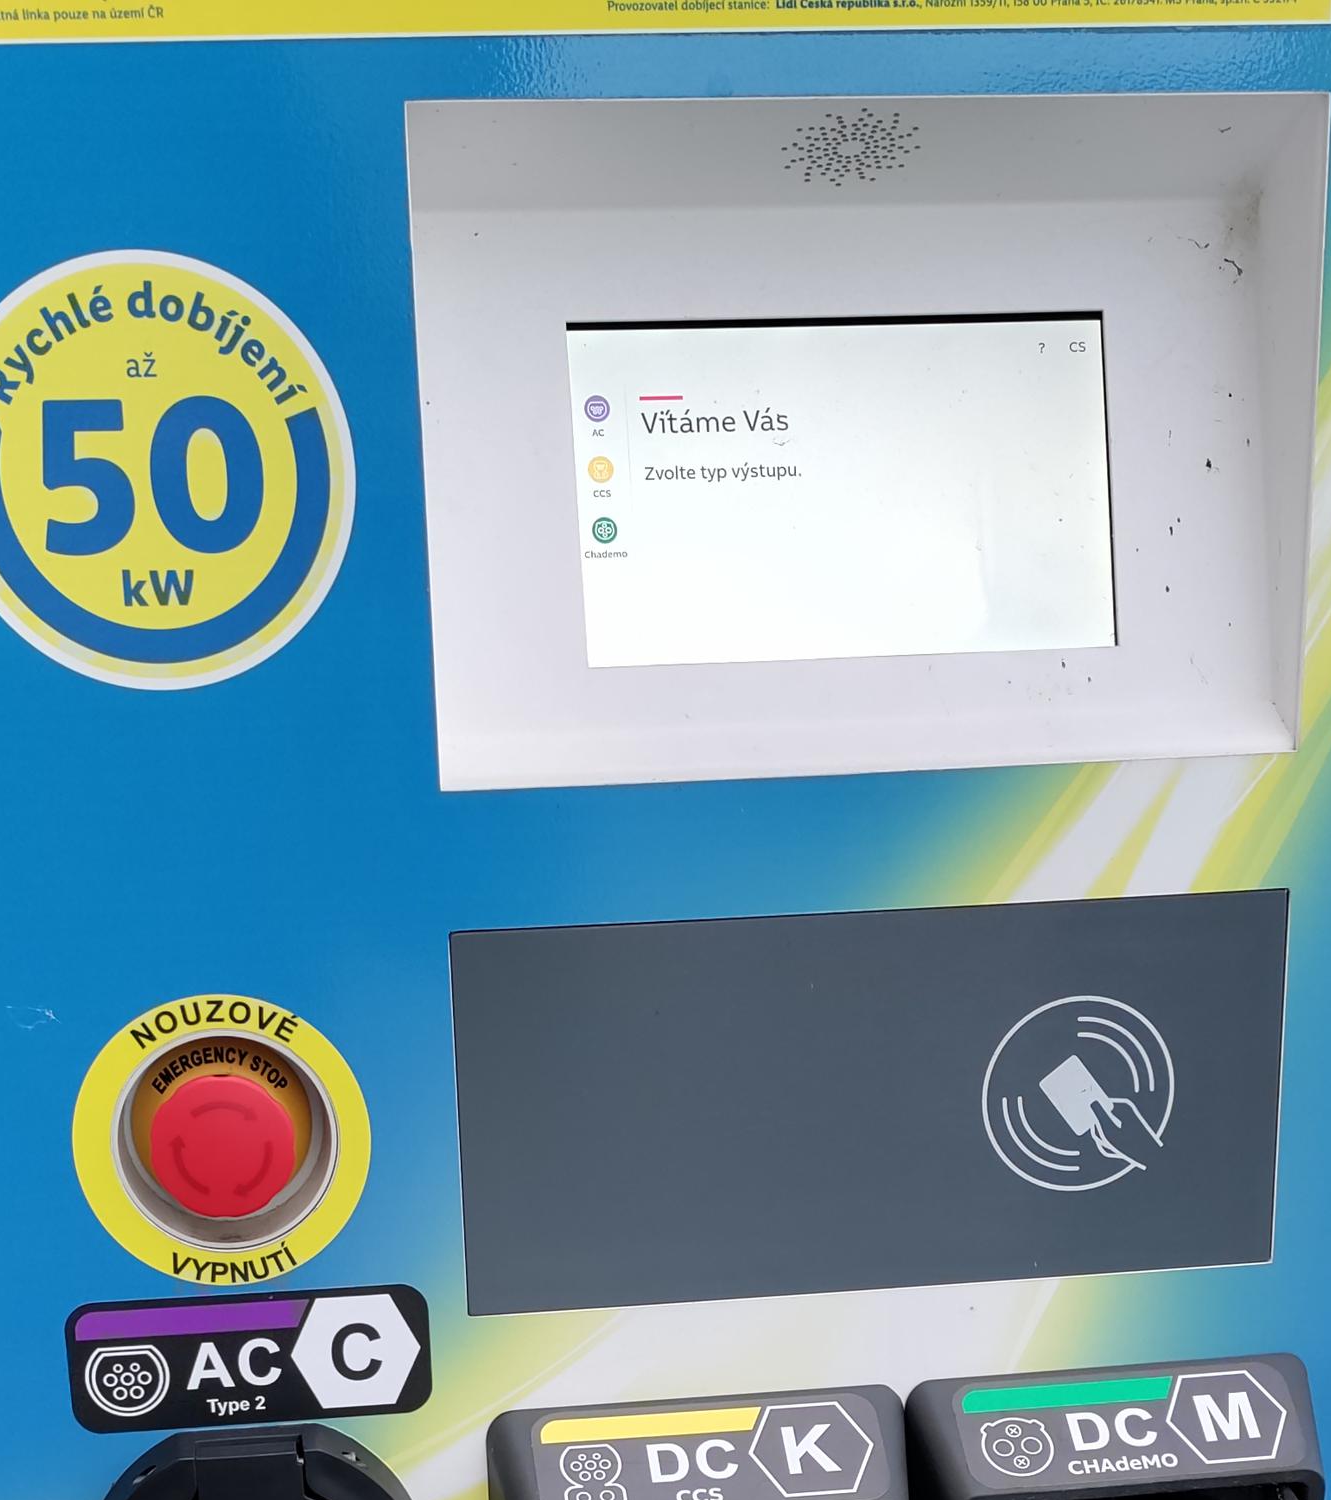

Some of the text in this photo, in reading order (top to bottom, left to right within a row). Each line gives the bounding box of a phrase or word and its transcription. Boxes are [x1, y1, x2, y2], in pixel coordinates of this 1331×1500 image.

[23, 8, 50, 20] linka
[54, 9, 89, 22] pouze
[92, 9, 106, 19] na
[110, 7, 144, 19] území
[147, 4, 164, 18] ČR
[607, 0, 677, 11] Provozovatel
[728, 0, 770, 10] stanice:
[776, 0, 796, 9] Lidl
[836, 0, 890, 10] republika
[127, 280, 308, 406] dobíjení
[1038, 341, 1086, 354] ? CS
[125, 351, 158, 378] až
[592, 428, 605, 437] AC
[641, 407, 789, 434] Vítáme Vás
[42, 395, 265, 556] 50
[644, 461, 803, 482] Zvolte typ výstupu.
[593, 489, 612, 498] CCS
[584, 550, 628, 559] Chademo
[121, 568, 195, 607] kW
[130, 999, 300, 1050] NOUZOVÉ
[151, 1046, 289, 1094] EMERGENCY STOP
[171, 1242, 298, 1284] VYPNUTÍ
[186, 1322, 384, 1391] AC C
[206, 1396, 267, 1418] Type 2
[1064, 1391, 1262, 1453] DC M
[644, 1423, 844, 1484] DC K
[1067, 1452, 1179, 1476] CHAdeMO
